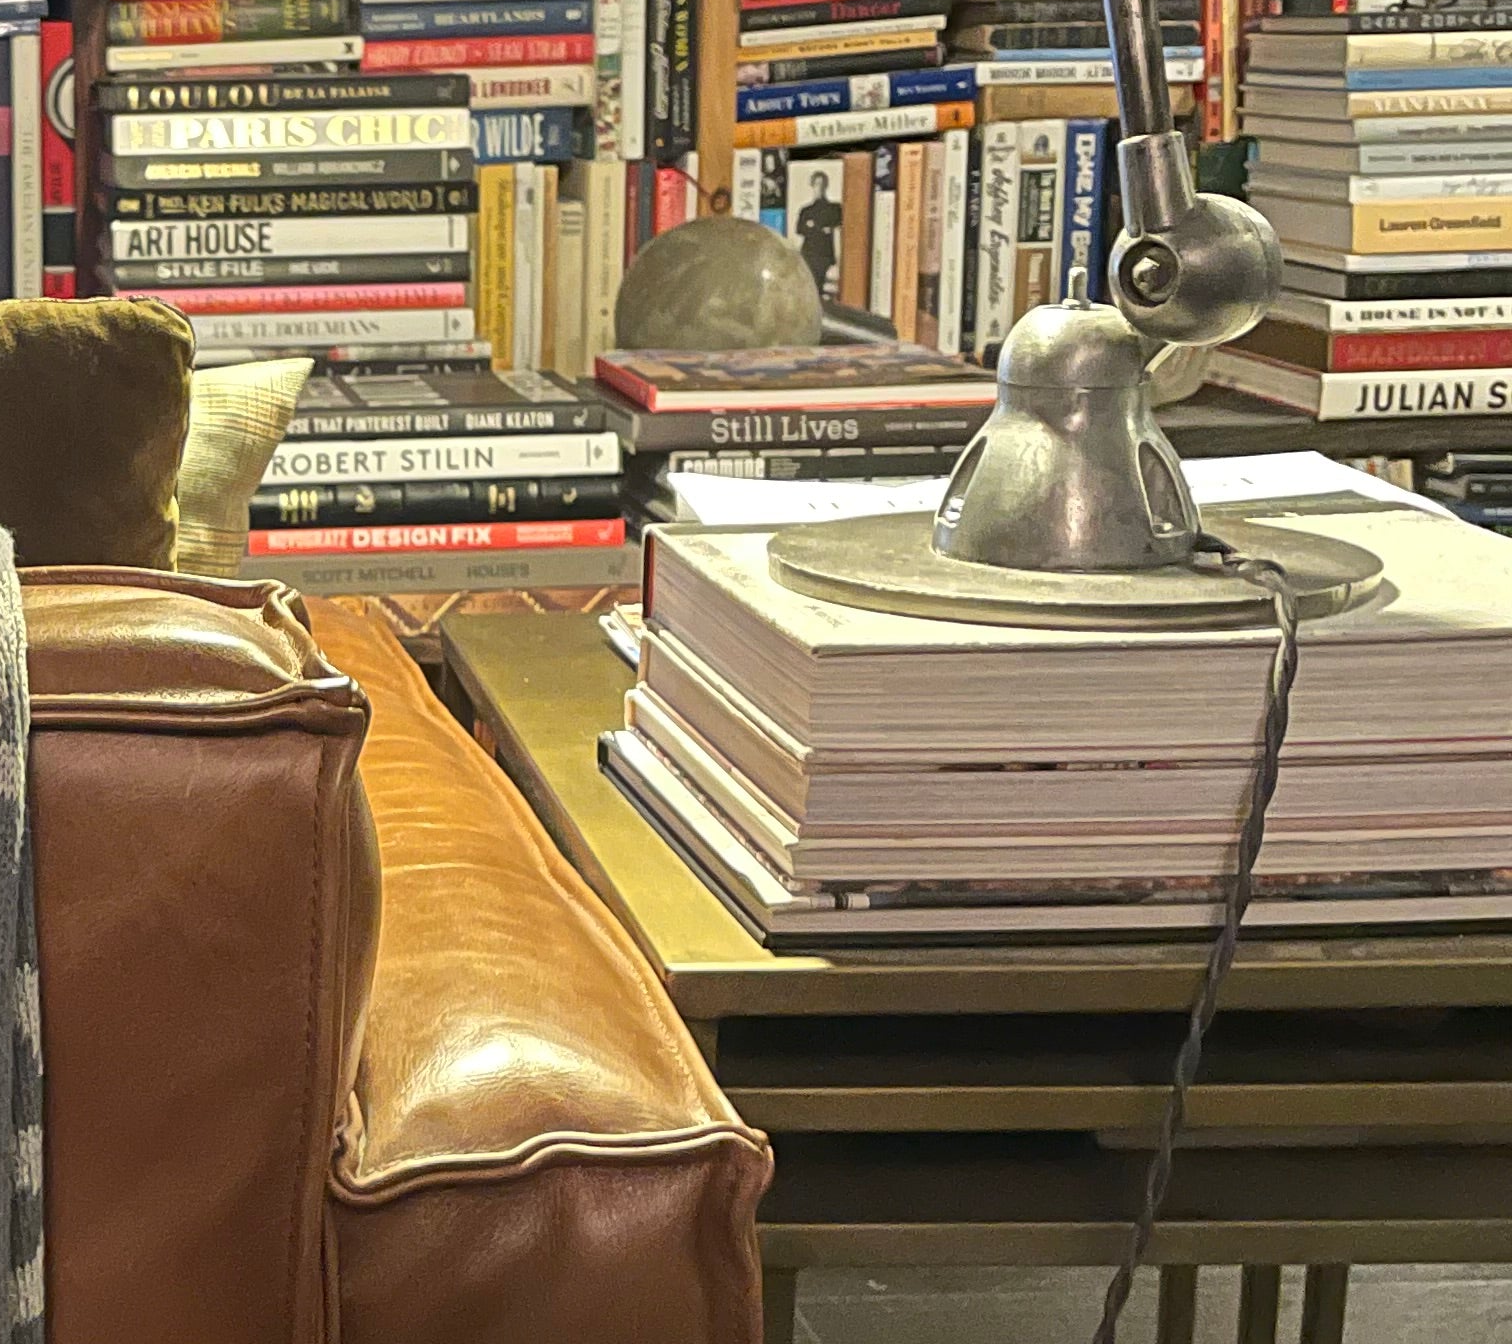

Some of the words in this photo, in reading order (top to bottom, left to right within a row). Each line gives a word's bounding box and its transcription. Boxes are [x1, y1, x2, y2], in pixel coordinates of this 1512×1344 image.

[169, 116, 318, 150] PARIS
[324, 113, 447, 146] CHIC
[486, 113, 544, 157] WILDE
[127, 225, 178, 258] ART
[186, 222, 273, 256] HOUSE
[156, 262, 217, 280] STYLE
[220, 260, 265, 278] FILE
[1354, 381, 1476, 413] JULIAN
[465, 413, 503, 429] DIANE
[505, 411, 555, 428] KEATON
[710, 417, 774, 444] Still
[781, 413, 859, 442] Lives
[271, 450, 388, 477] ROBERT
[400, 446, 495, 472] STILIN
[352, 525, 447, 548] DESIGN
[450, 524, 492, 545] FIX
